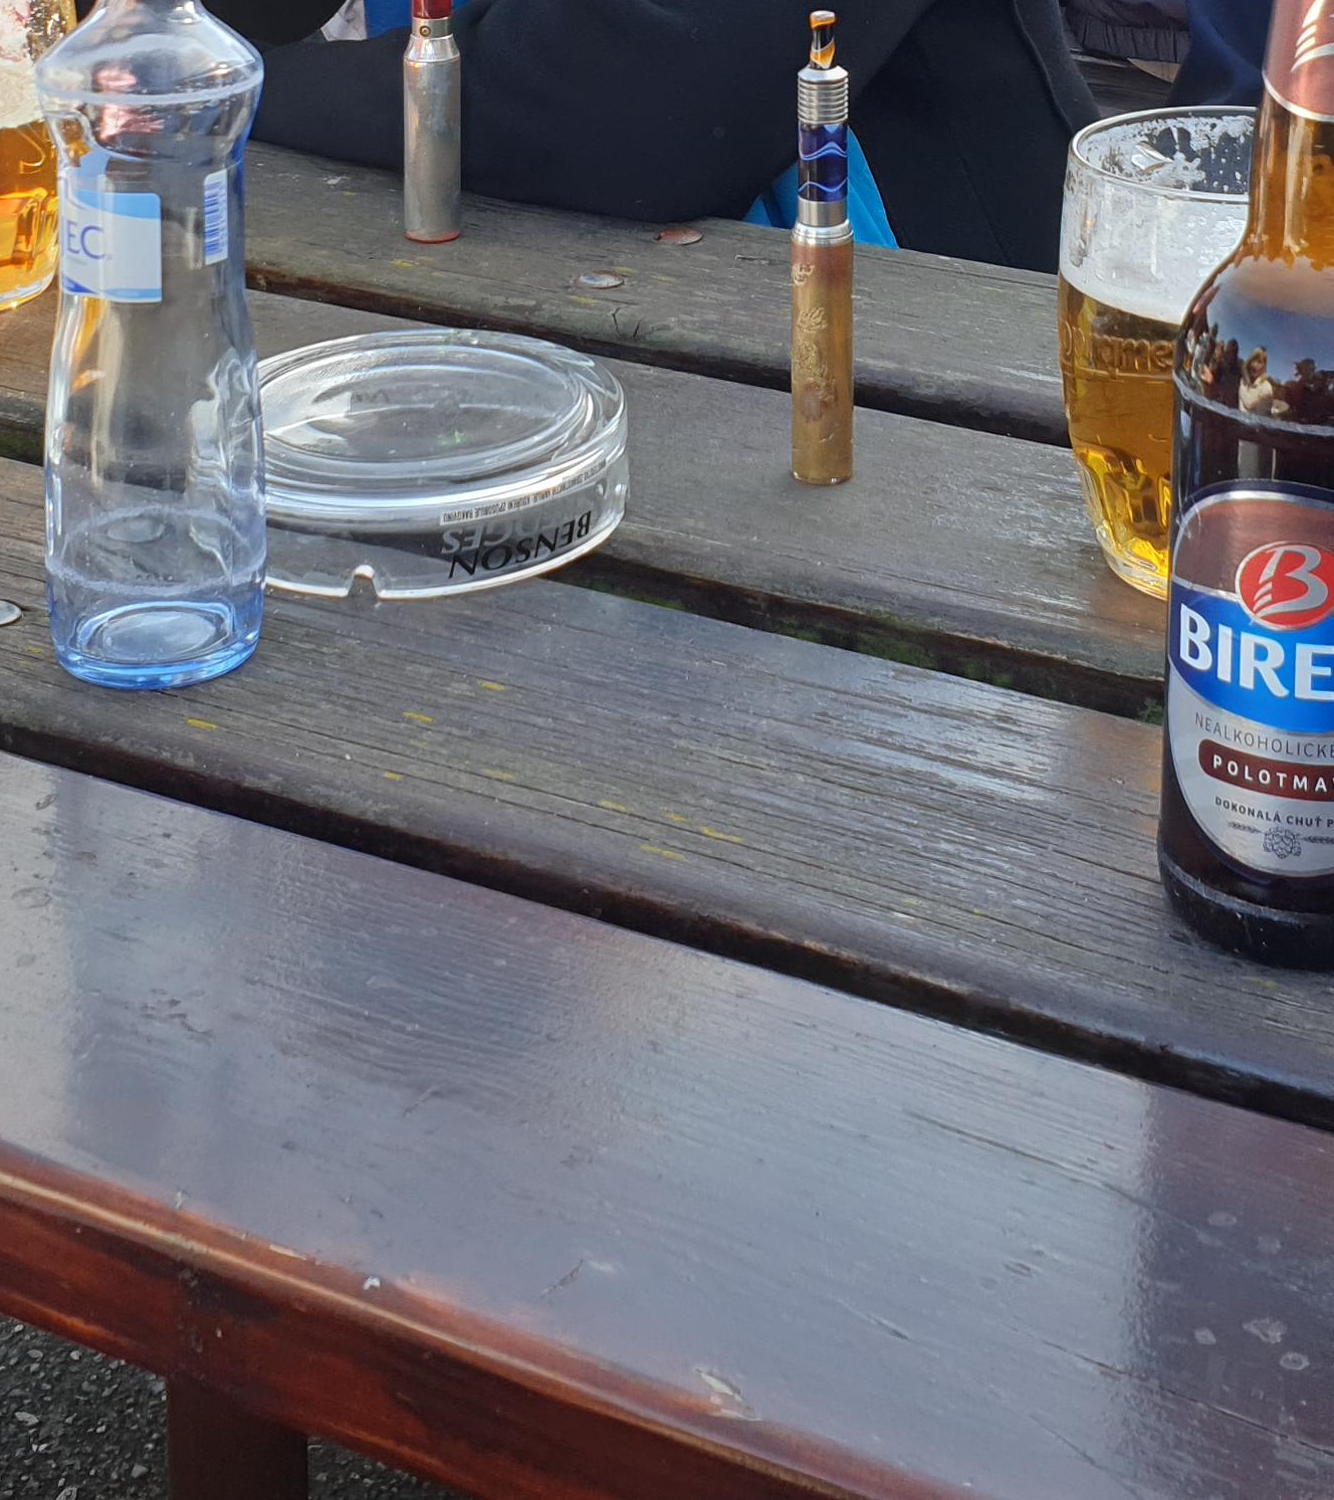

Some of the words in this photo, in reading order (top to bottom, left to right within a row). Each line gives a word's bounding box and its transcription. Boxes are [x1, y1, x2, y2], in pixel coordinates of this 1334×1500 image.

[448, 510, 592, 580] BENSON
[1252, 547, 1329, 621] B
[1214, 795, 1282, 824] DOKONALÁ
